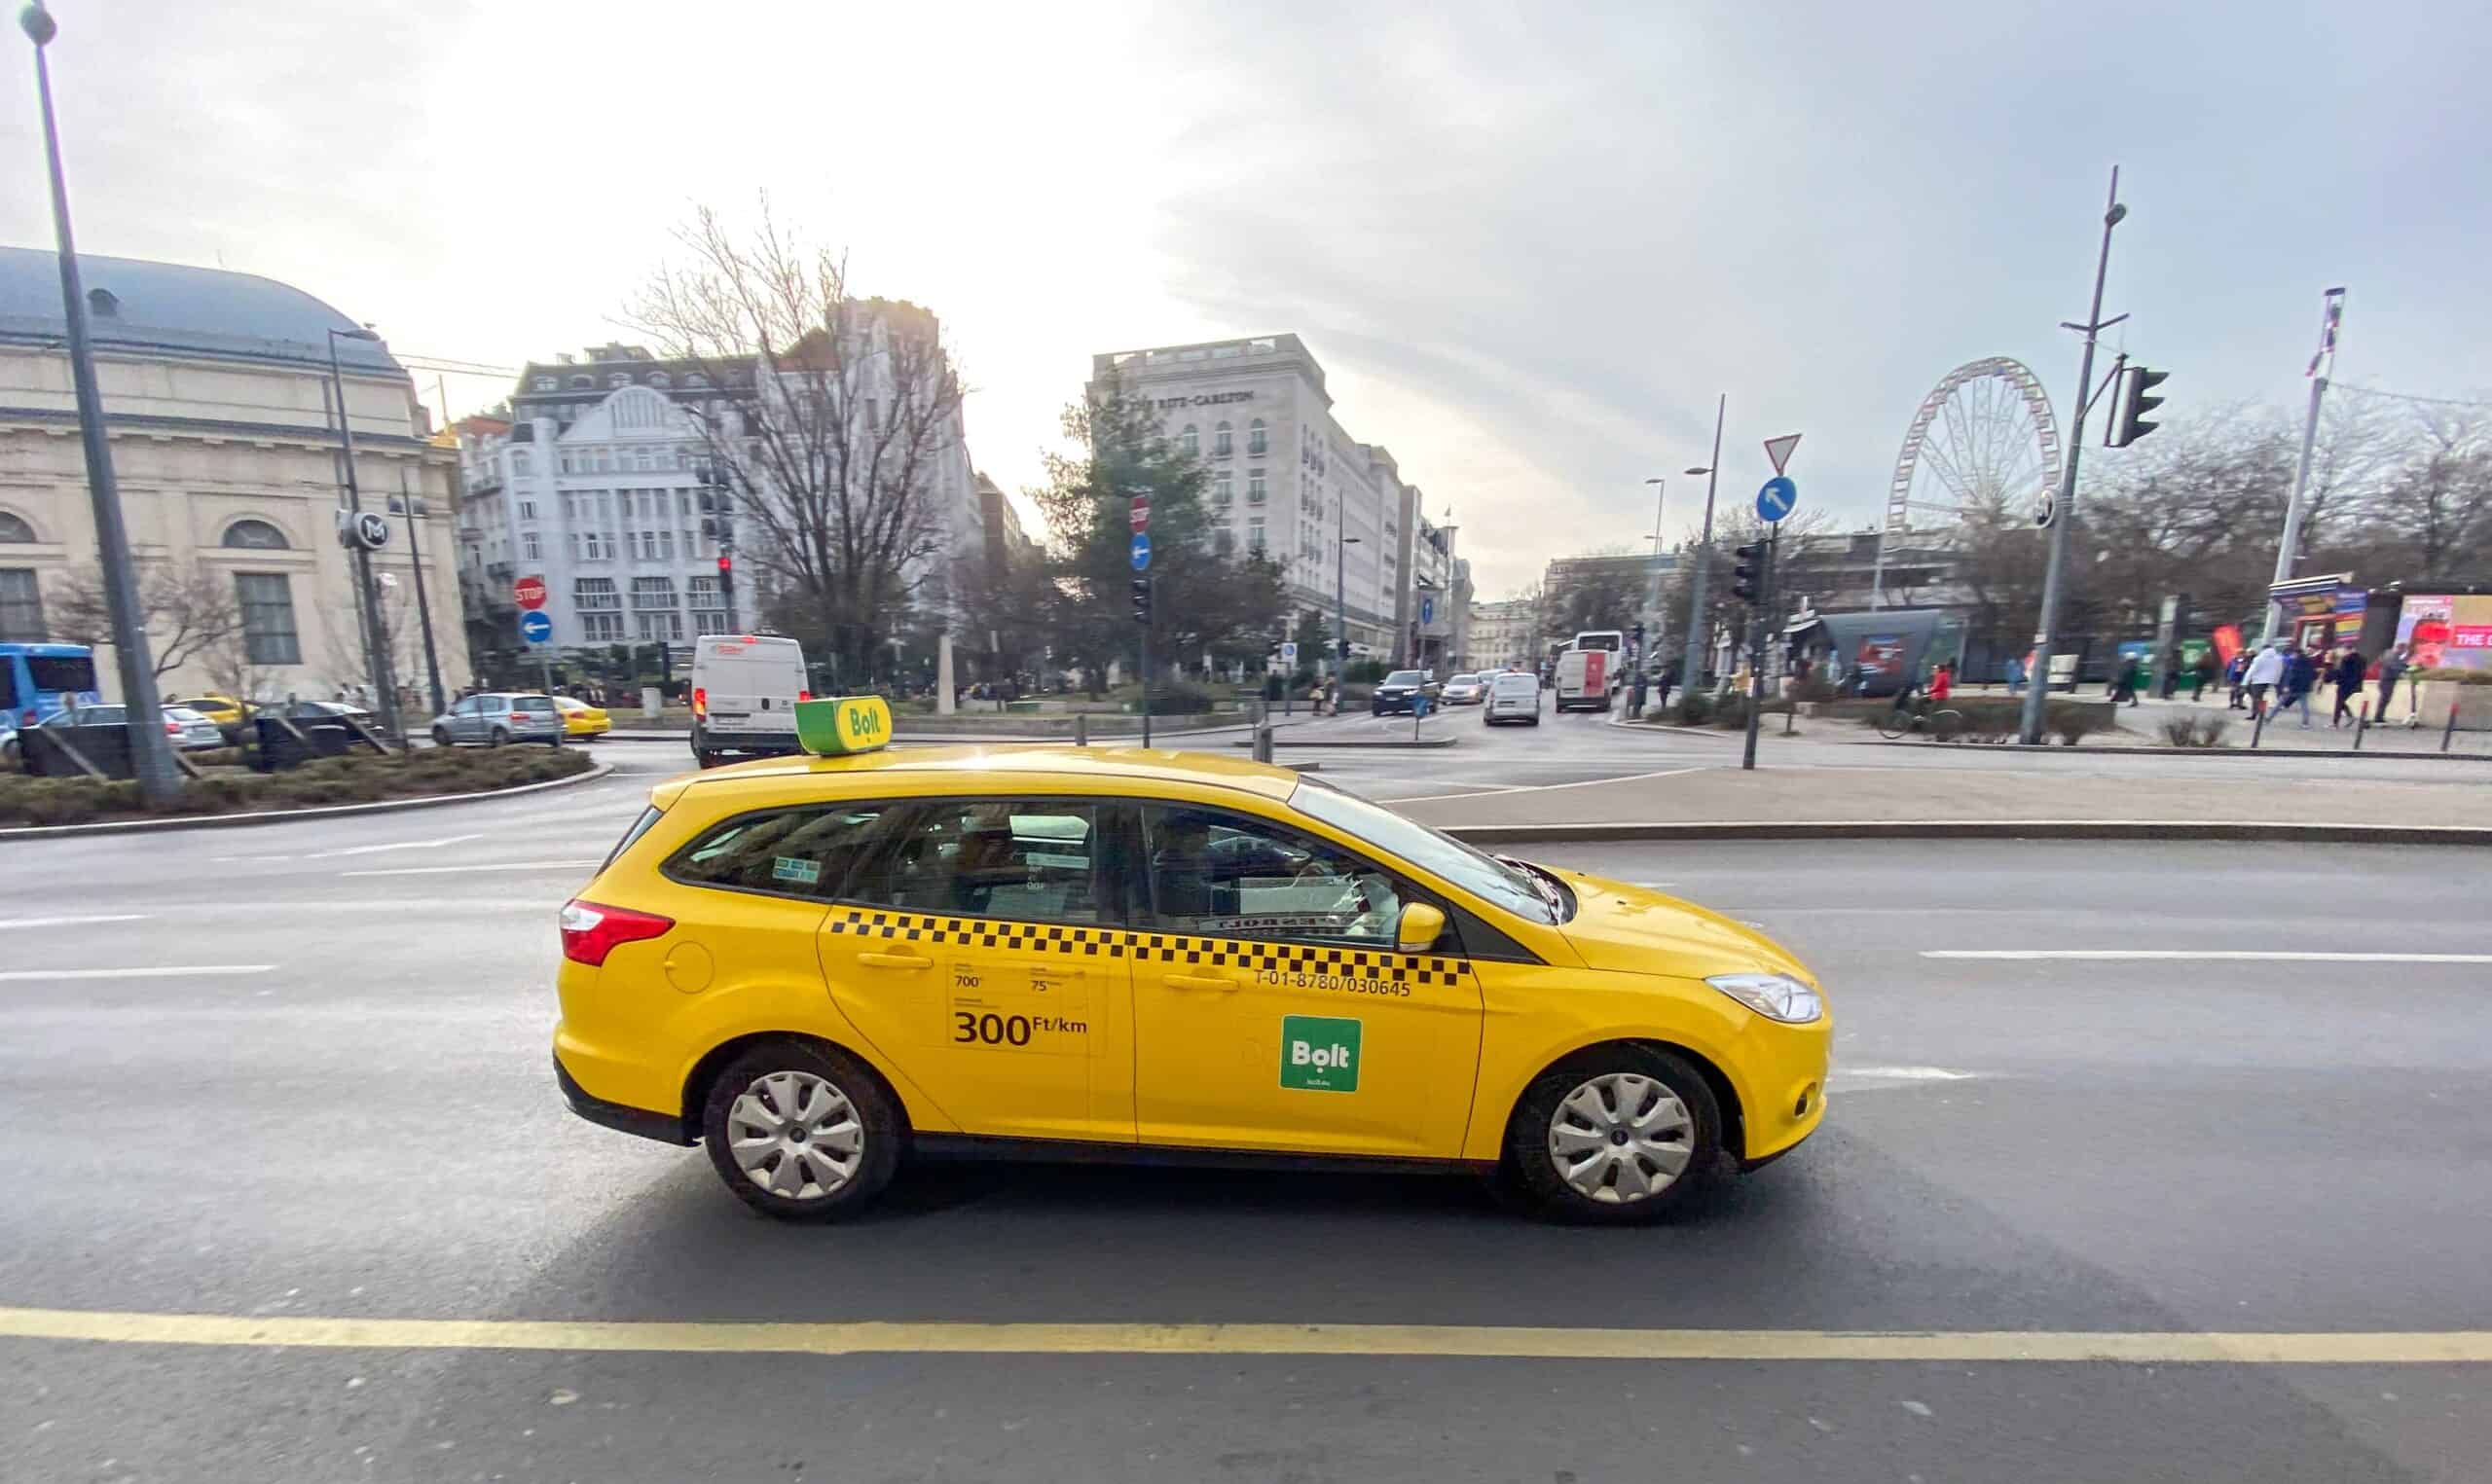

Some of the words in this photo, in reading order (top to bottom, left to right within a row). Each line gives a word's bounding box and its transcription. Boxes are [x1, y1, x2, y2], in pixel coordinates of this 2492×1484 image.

[1129, 507, 1150, 524] STOP
[514, 587, 546, 601] STOP
[850, 706, 882, 743] Bolt
[955, 975, 979, 988] 700
[1032, 980, 1047, 992] 75
[1254, 969, 1411, 997] T-01-8780/030645
[955, 1011, 1032, 1046] 300
[1032, 1016, 1088, 1034] Ft/km
[1292, 1040, 1350, 1073] Bolt
